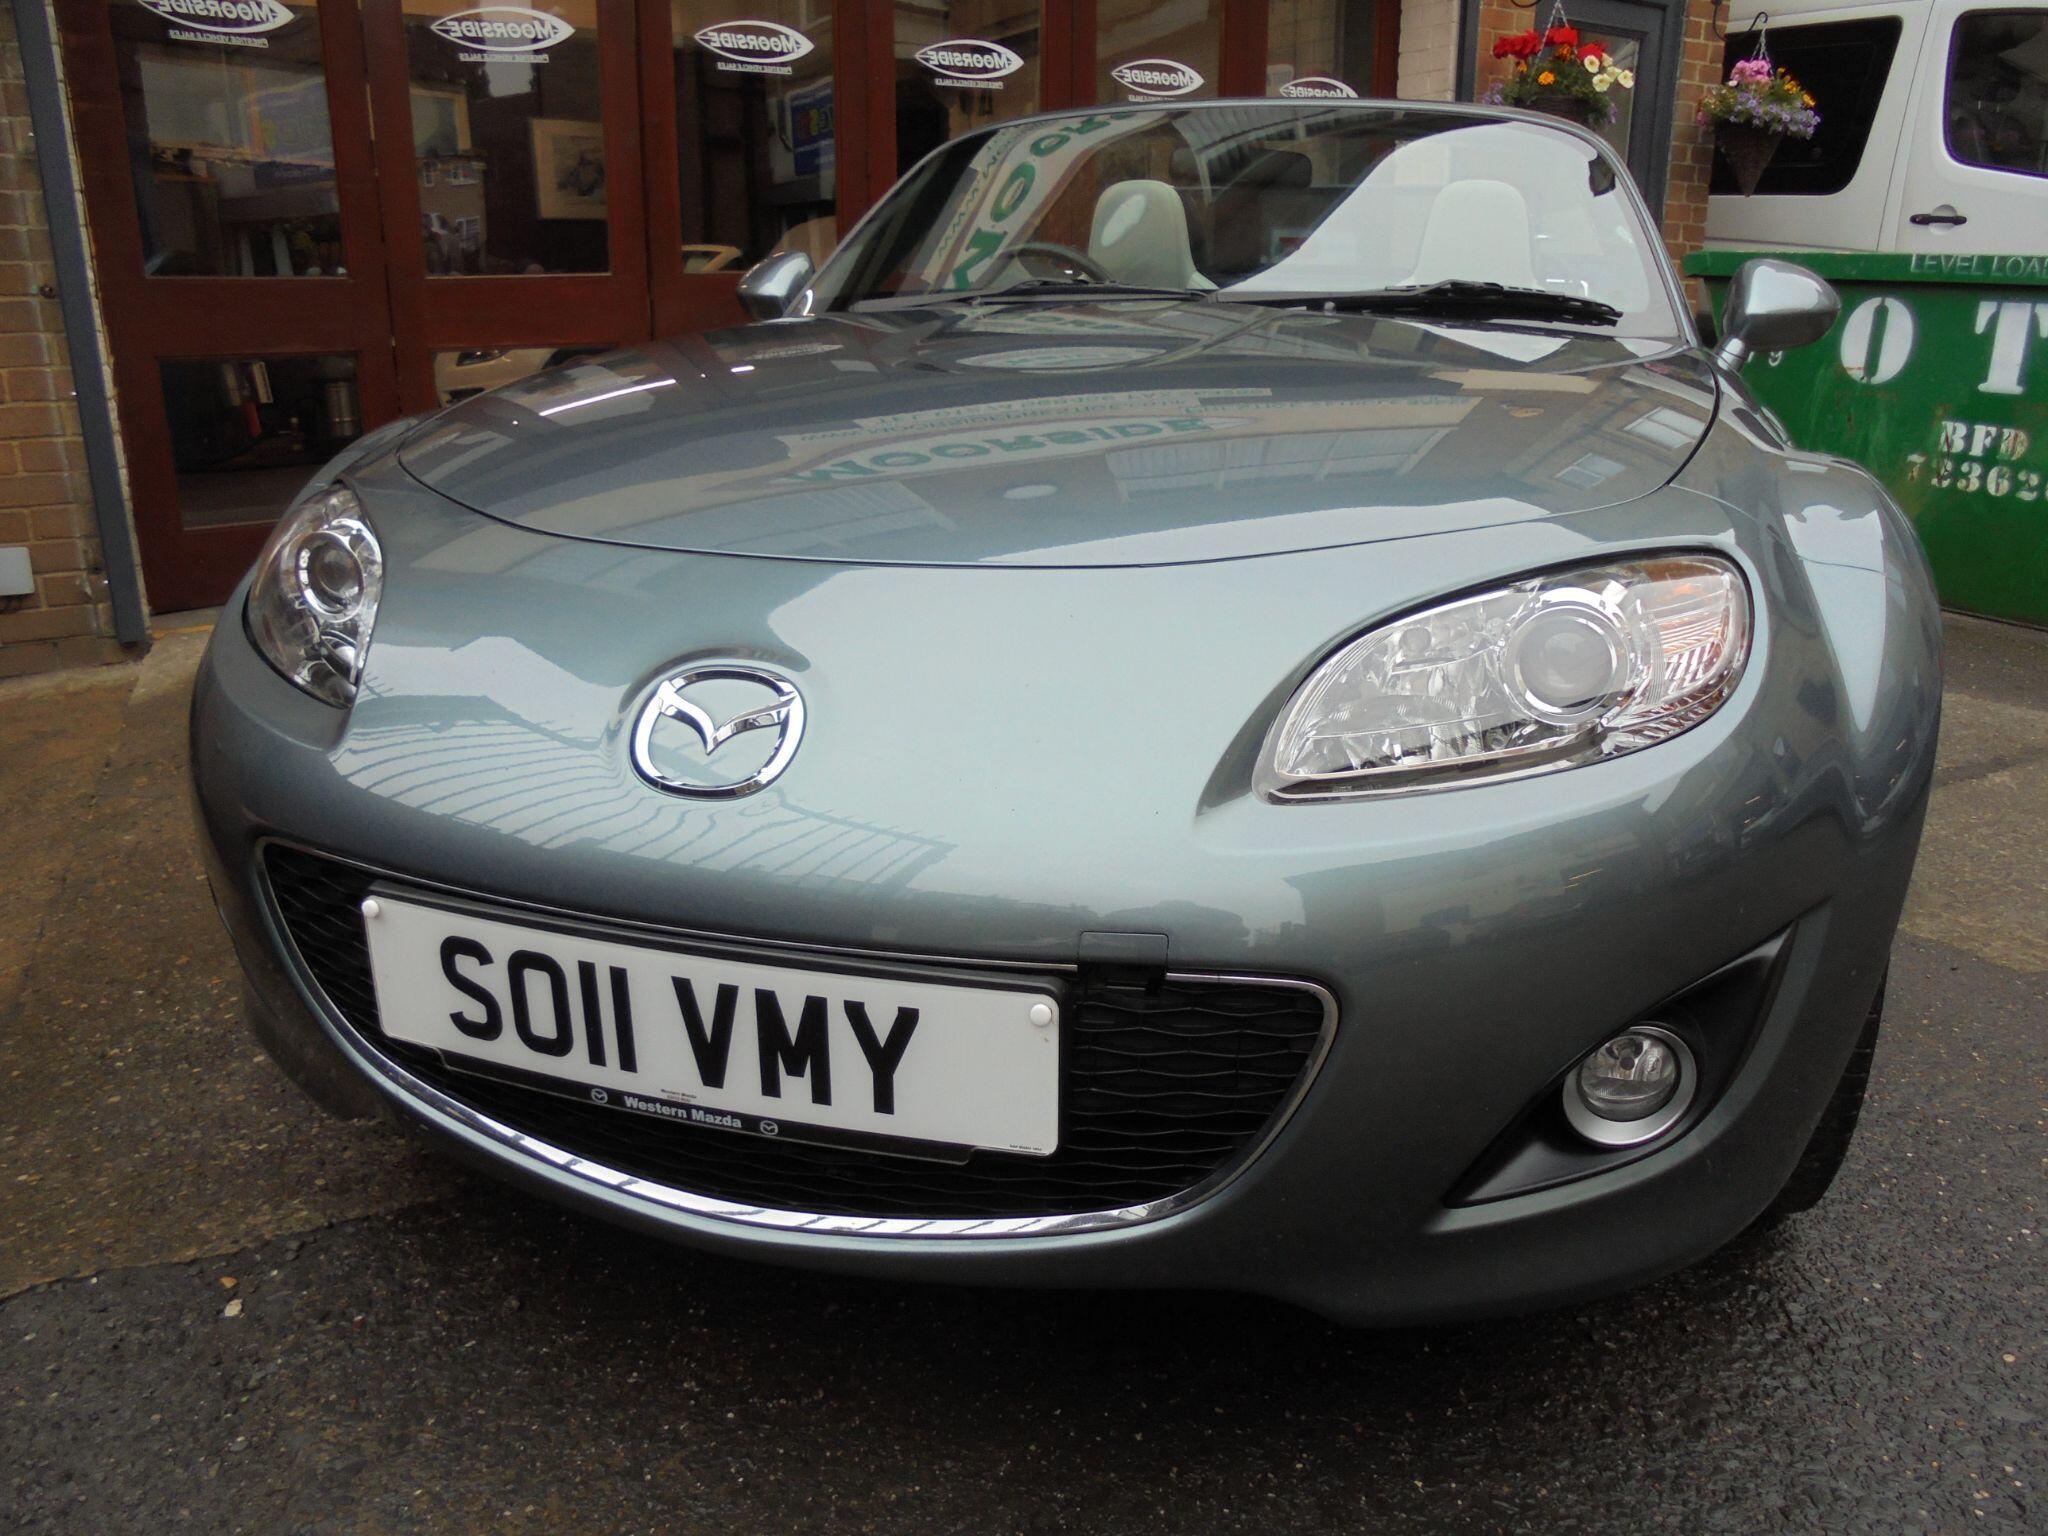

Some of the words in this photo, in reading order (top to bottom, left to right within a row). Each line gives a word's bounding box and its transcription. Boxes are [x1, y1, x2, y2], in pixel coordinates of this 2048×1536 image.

[1910, 254, 1984, 276] LEVEL
[1991, 255, 2048, 277] LOA
[438, 935, 638, 1075] SO11
[670, 976, 920, 1116] VMY
[623, 1095, 688, 1118] Western
[691, 1107, 742, 1129] Mazda
